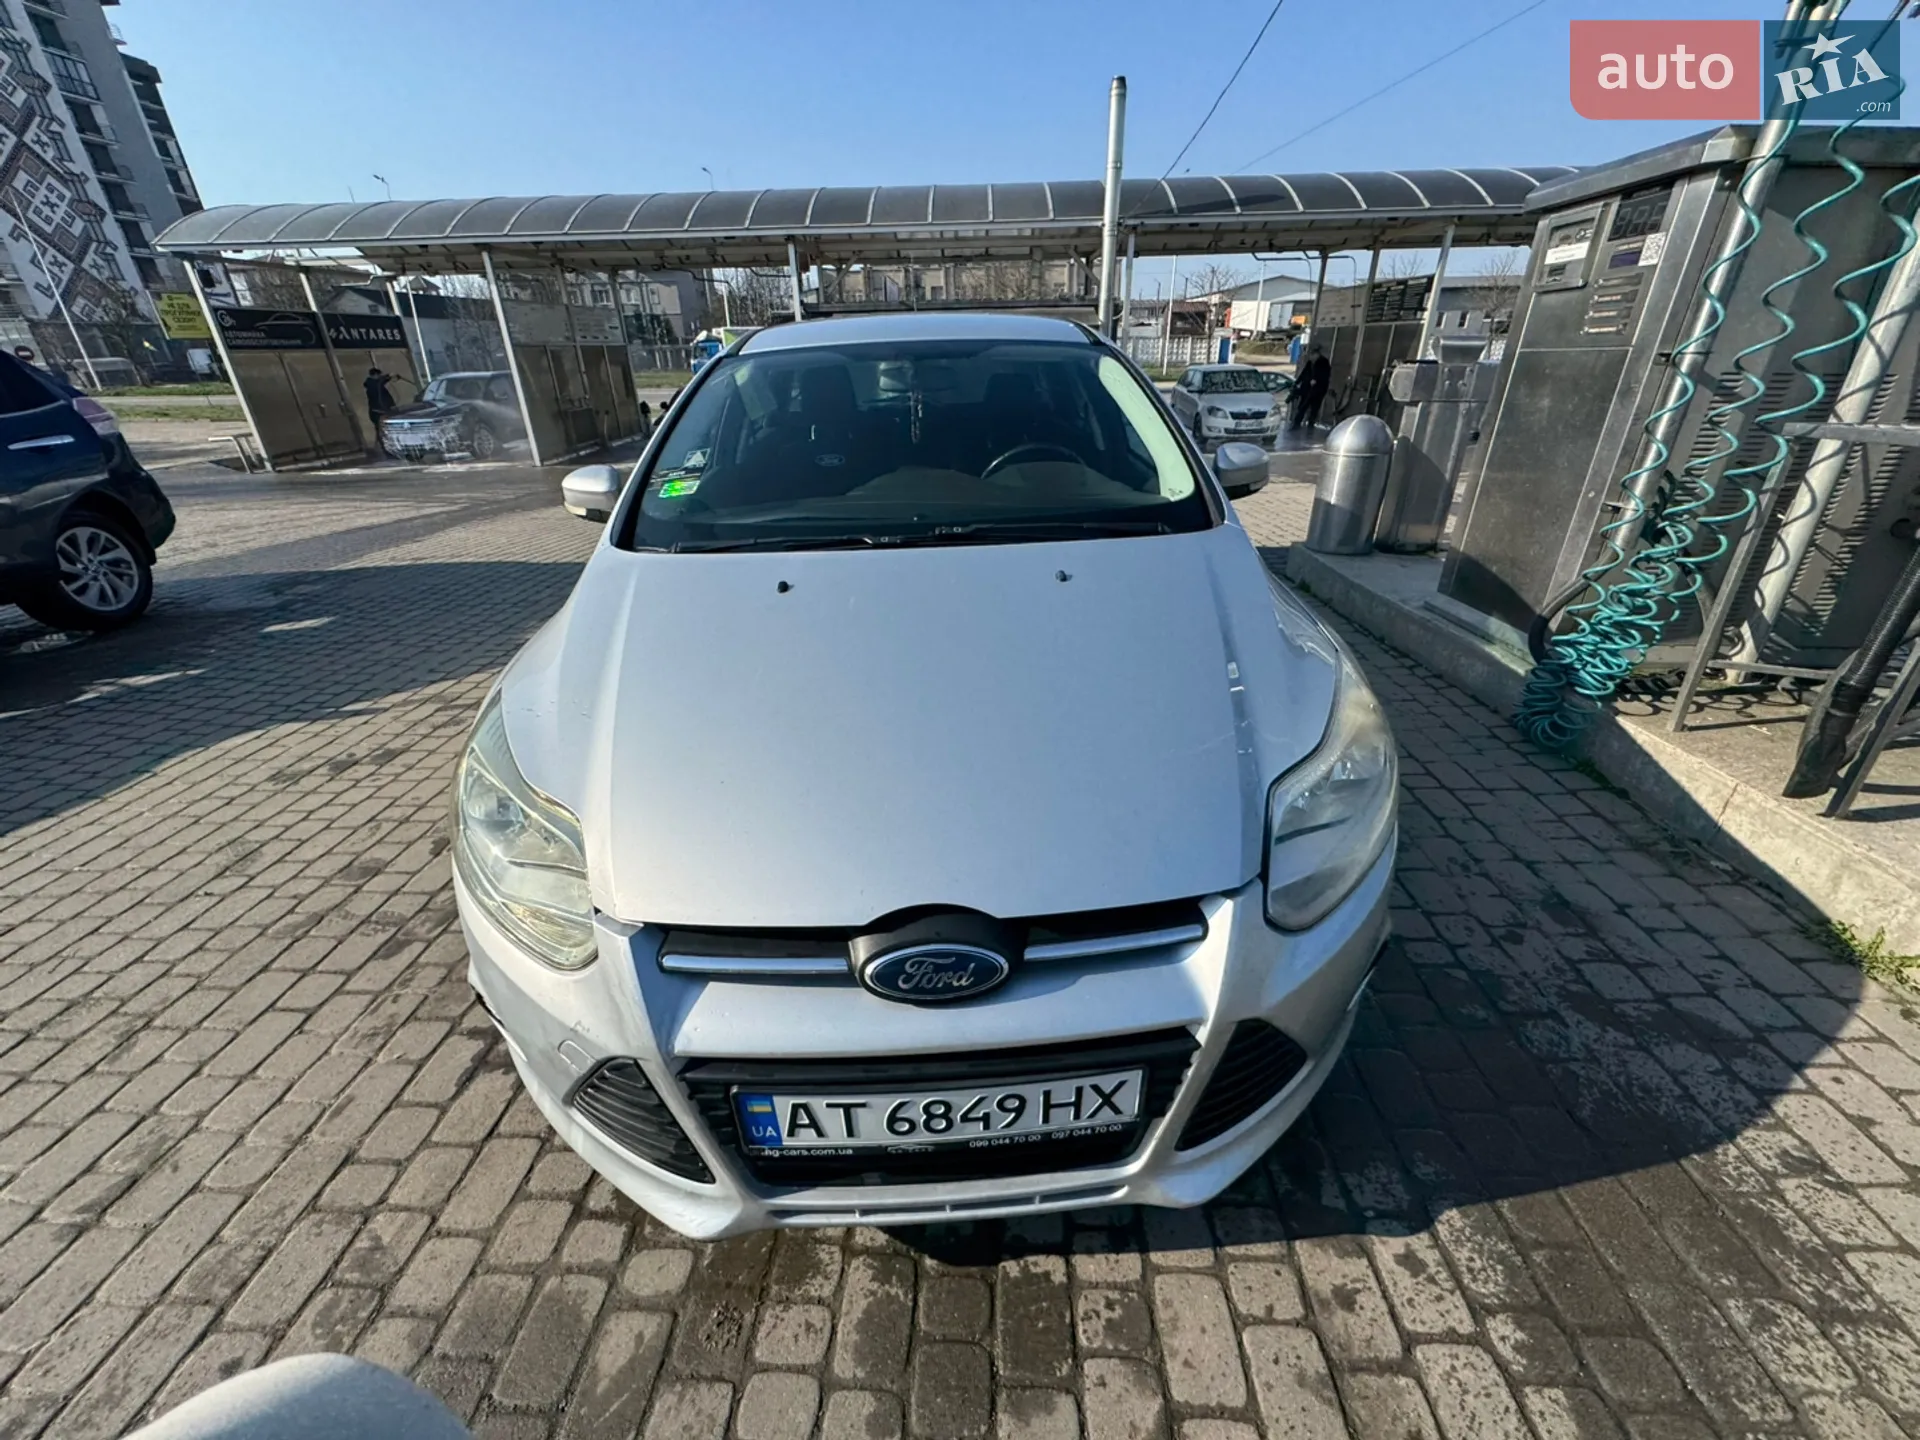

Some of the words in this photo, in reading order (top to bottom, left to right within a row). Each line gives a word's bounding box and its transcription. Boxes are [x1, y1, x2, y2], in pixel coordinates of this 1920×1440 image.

[339, 326, 401, 341] ANTARES
[897, 957, 976, 990] Ford
[785, 1100, 867, 1139] AT
[884, 1093, 1027, 1137] 6849
[1039, 1079, 1129, 1126] HX
[752, 1126, 777, 1138] UA
[1094, 1126, 1107, 1134] 70
[1109, 1124, 1122, 1132] 00
[1013, 1136, 1026, 1144] 70
[1027, 1134, 1041, 1142] 00
